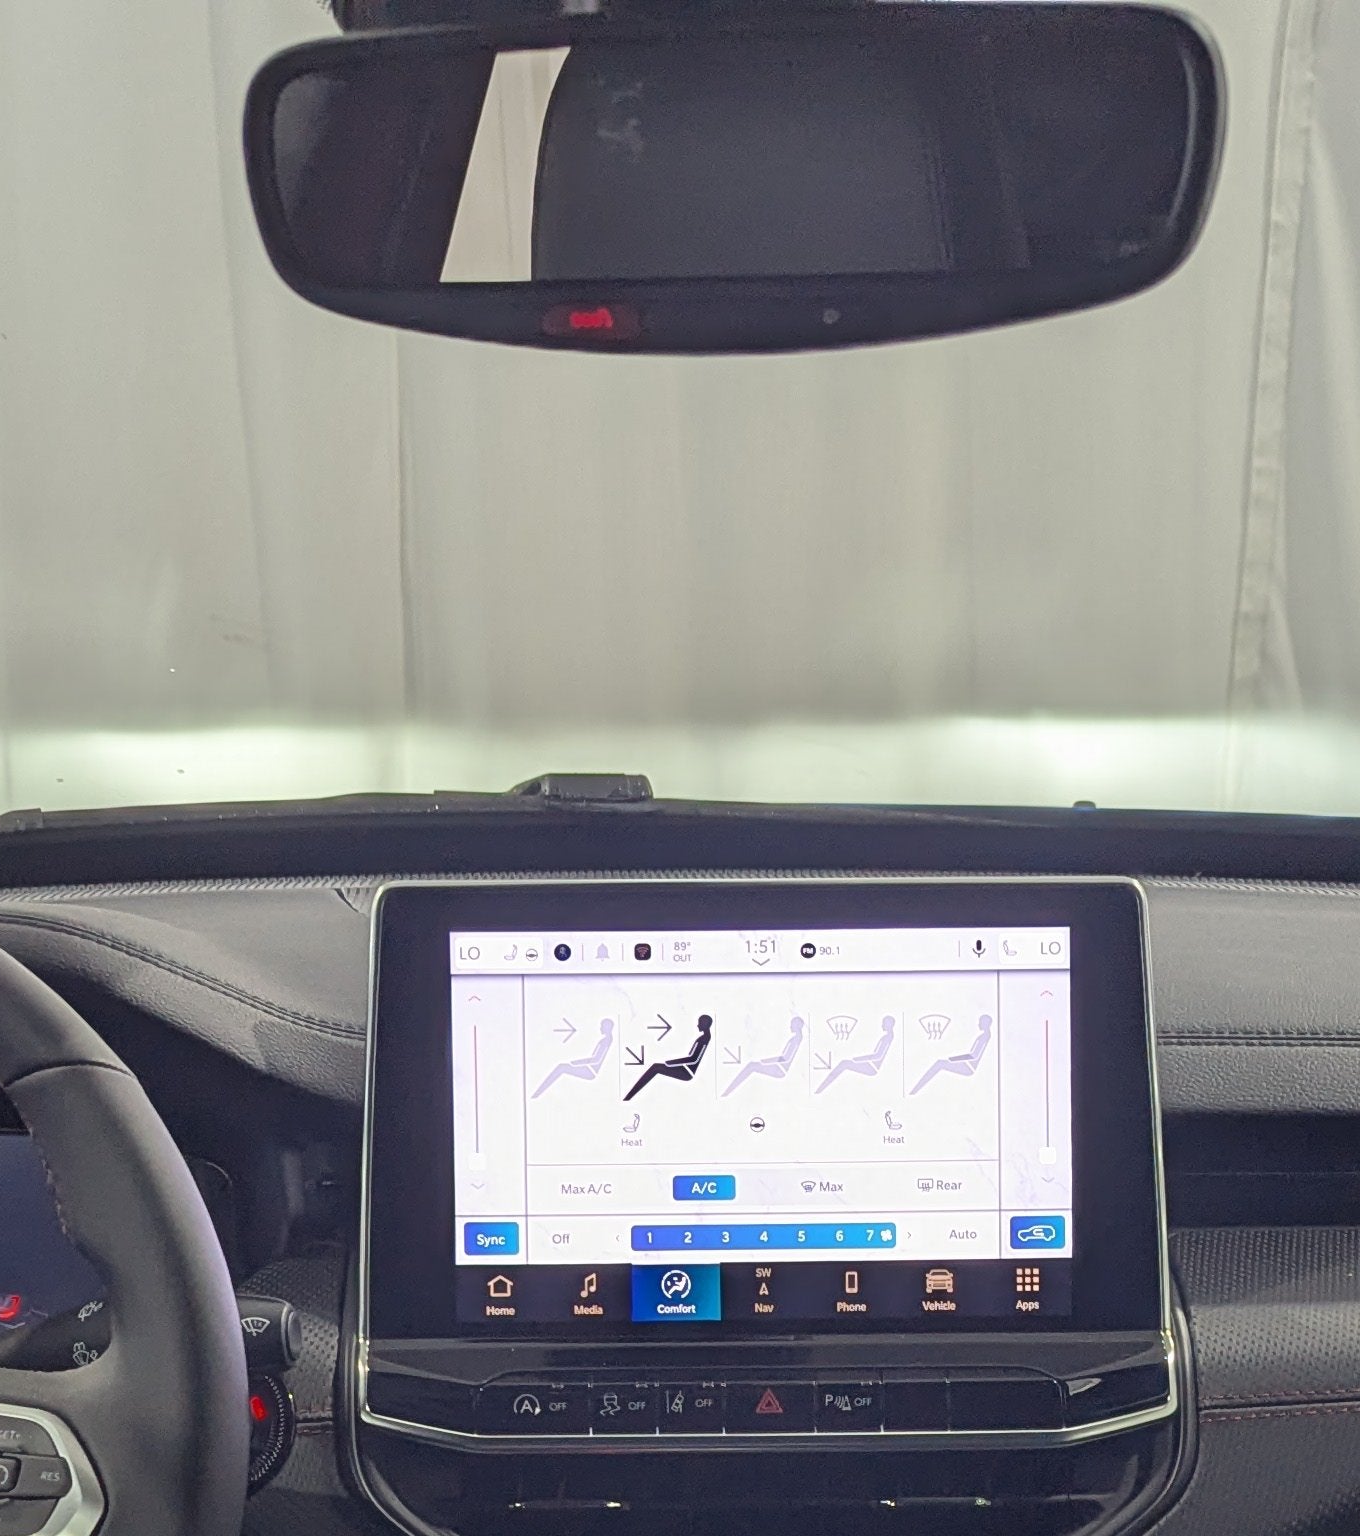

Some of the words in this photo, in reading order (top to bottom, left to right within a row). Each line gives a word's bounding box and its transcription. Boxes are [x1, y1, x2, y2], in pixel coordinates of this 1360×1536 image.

[744, 939, 777, 953] 1:51
[819, 946, 840, 956] 90.1
[1040, 942, 1061, 955] LO
[459, 946, 481, 960] LO
[673, 953, 691, 963] OUT
[620, 1137, 643, 1147] Heat
[883, 1135, 905, 1145] Heat
[560, 1184, 585, 1195] Max
[587, 1183, 613, 1195] A/C
[691, 1182, 717, 1194] A/C
[819, 1181, 844, 1192] Max
[936, 1180, 962, 1191] Rear
[476, 1233, 506, 1247] Sync
[552, 1233, 571, 1244] Off
[646, 1232, 653, 1243] 1
[684, 1232, 692, 1243] 2
[721, 1232, 730, 1243] 3
[759, 1231, 768, 1242] 4
[797, 1231, 806, 1242] 5
[835, 1230, 844, 1242] 6
[865, 1230, 874, 1241] 7
[949, 1229, 977, 1240] Auto
[755, 1268, 772, 1278] SW
[485, 1305, 516, 1316] Home
[573, 1304, 604, 1316] Media
[657, 1304, 696, 1314] Comfort
[754, 1303, 774, 1313] Nav
[836, 1302, 867, 1312] Phone
[922, 1300, 956, 1311] Vehicle
[1016, 1300, 1040, 1311] Apps
[549, 1401, 566, 1411] OFF
[628, 1401, 646, 1411] OFF
[695, 1398, 713, 1409] OFF
[854, 1397, 872, 1407] OFF
